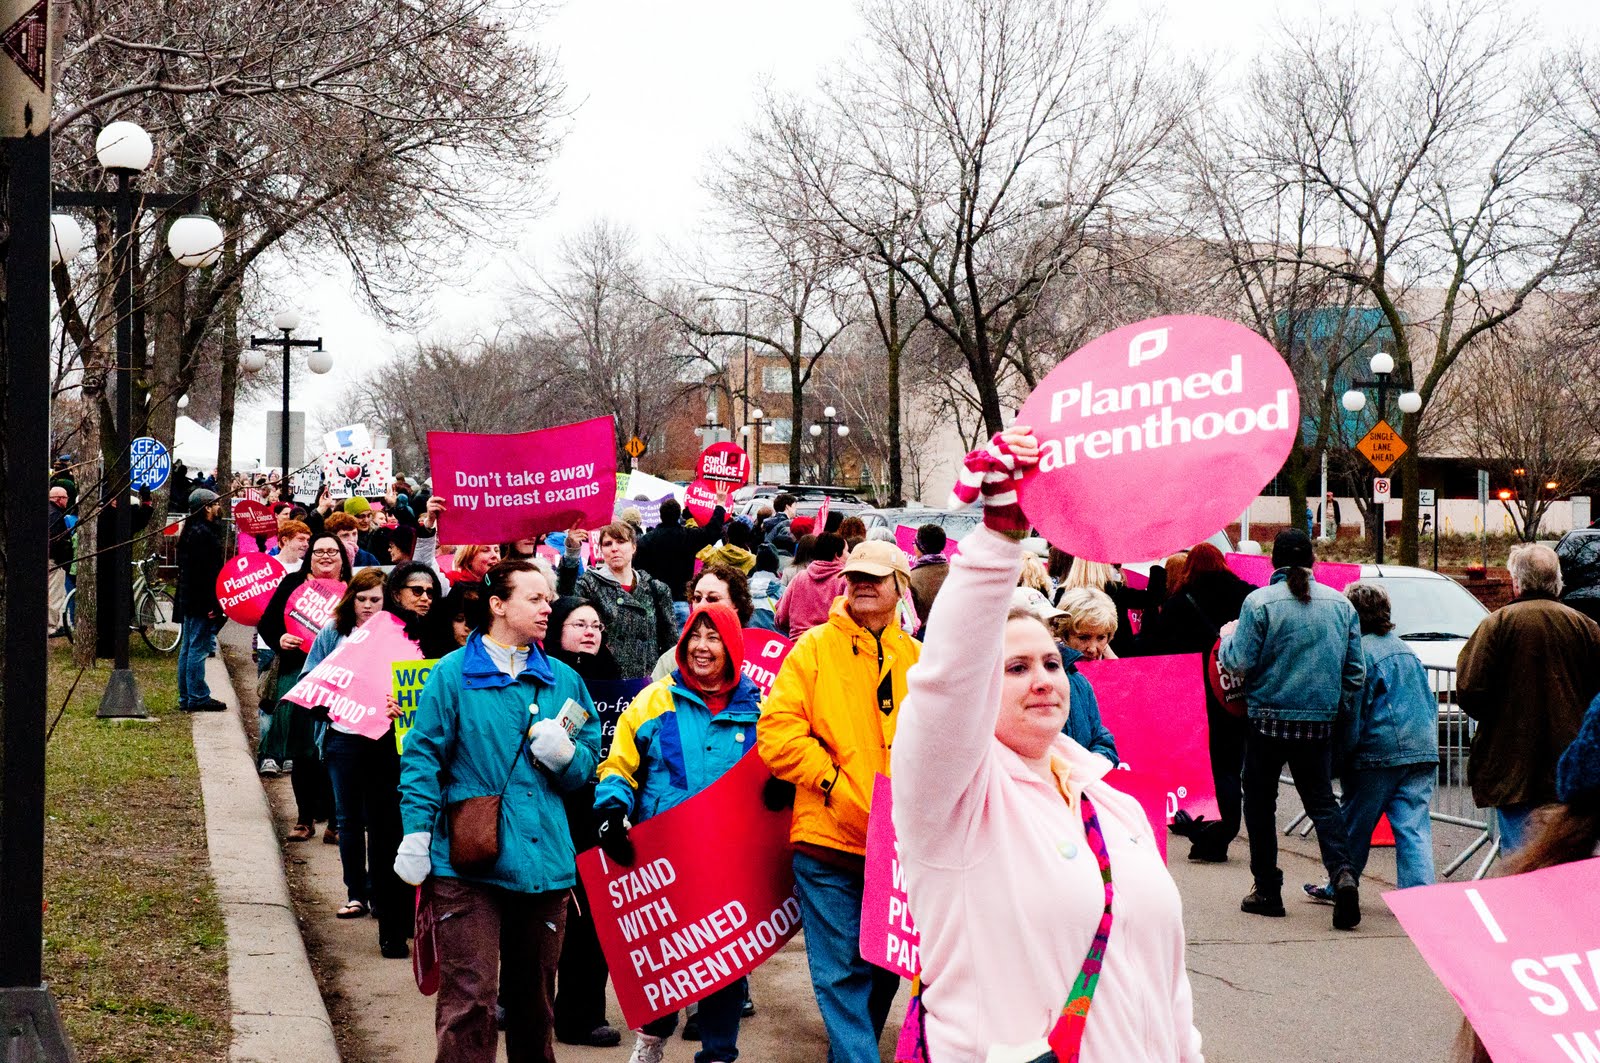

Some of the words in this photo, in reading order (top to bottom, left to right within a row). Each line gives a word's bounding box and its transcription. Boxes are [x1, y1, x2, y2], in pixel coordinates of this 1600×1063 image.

[1050, 354, 1243, 423] Planned
[1038, 389, 1289, 473] arenthood
[1370, 432, 1394, 441] SINGLE
[130, 440, 160, 455] KEEP
[337, 454, 360, 465] WE
[1371, 454, 1394, 462] AHEAD
[1373, 443, 1391, 451] LANE
[703, 455, 720, 465] FOR
[133, 469, 164, 486] EGAL
[455, 471, 502, 488] Don't
[506, 470, 545, 487] take
[550, 462, 595, 482] away
[453, 493, 479, 511] my
[484, 492, 541, 508] breast
[544, 481, 600, 503] exams
[692, 486, 717, 500] Plann
[223, 562, 273, 593] Planned
[302, 586, 327, 610] FOR
[396, 668, 430, 687] WO
[598, 848, 609, 875] I
[608, 857, 677, 909] STAND
[617, 897, 678, 943] WITH
[1464, 888, 1508, 943] I
[629, 900, 748, 978] PLANNED
